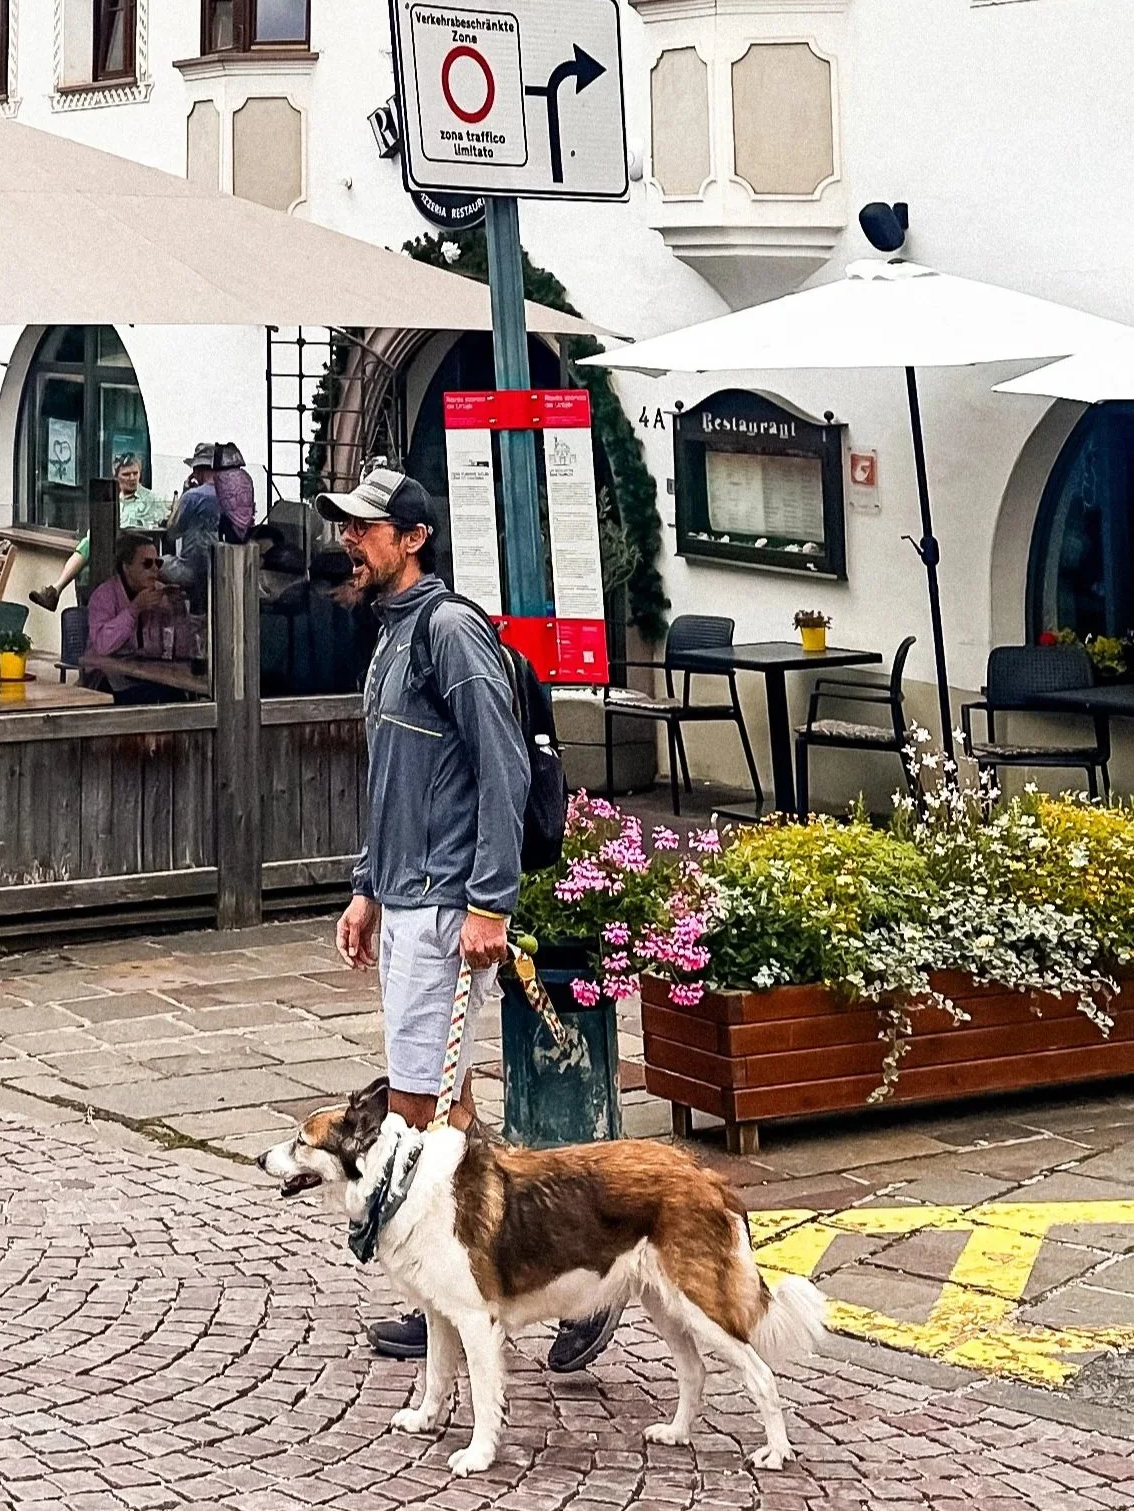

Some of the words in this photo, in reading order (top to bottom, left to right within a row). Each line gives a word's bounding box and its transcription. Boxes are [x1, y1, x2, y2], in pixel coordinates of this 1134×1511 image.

[415, 11, 515, 32] Verkehrsbeschränkte
[452, 30, 478, 44] Zone
[440, 130, 464, 141] zona
[466, 129, 506, 144] traffico
[454, 143, 494, 158] limitato
[420, 192, 447, 218] IZZERIA
[702, 412, 796, 439] Restaurant
